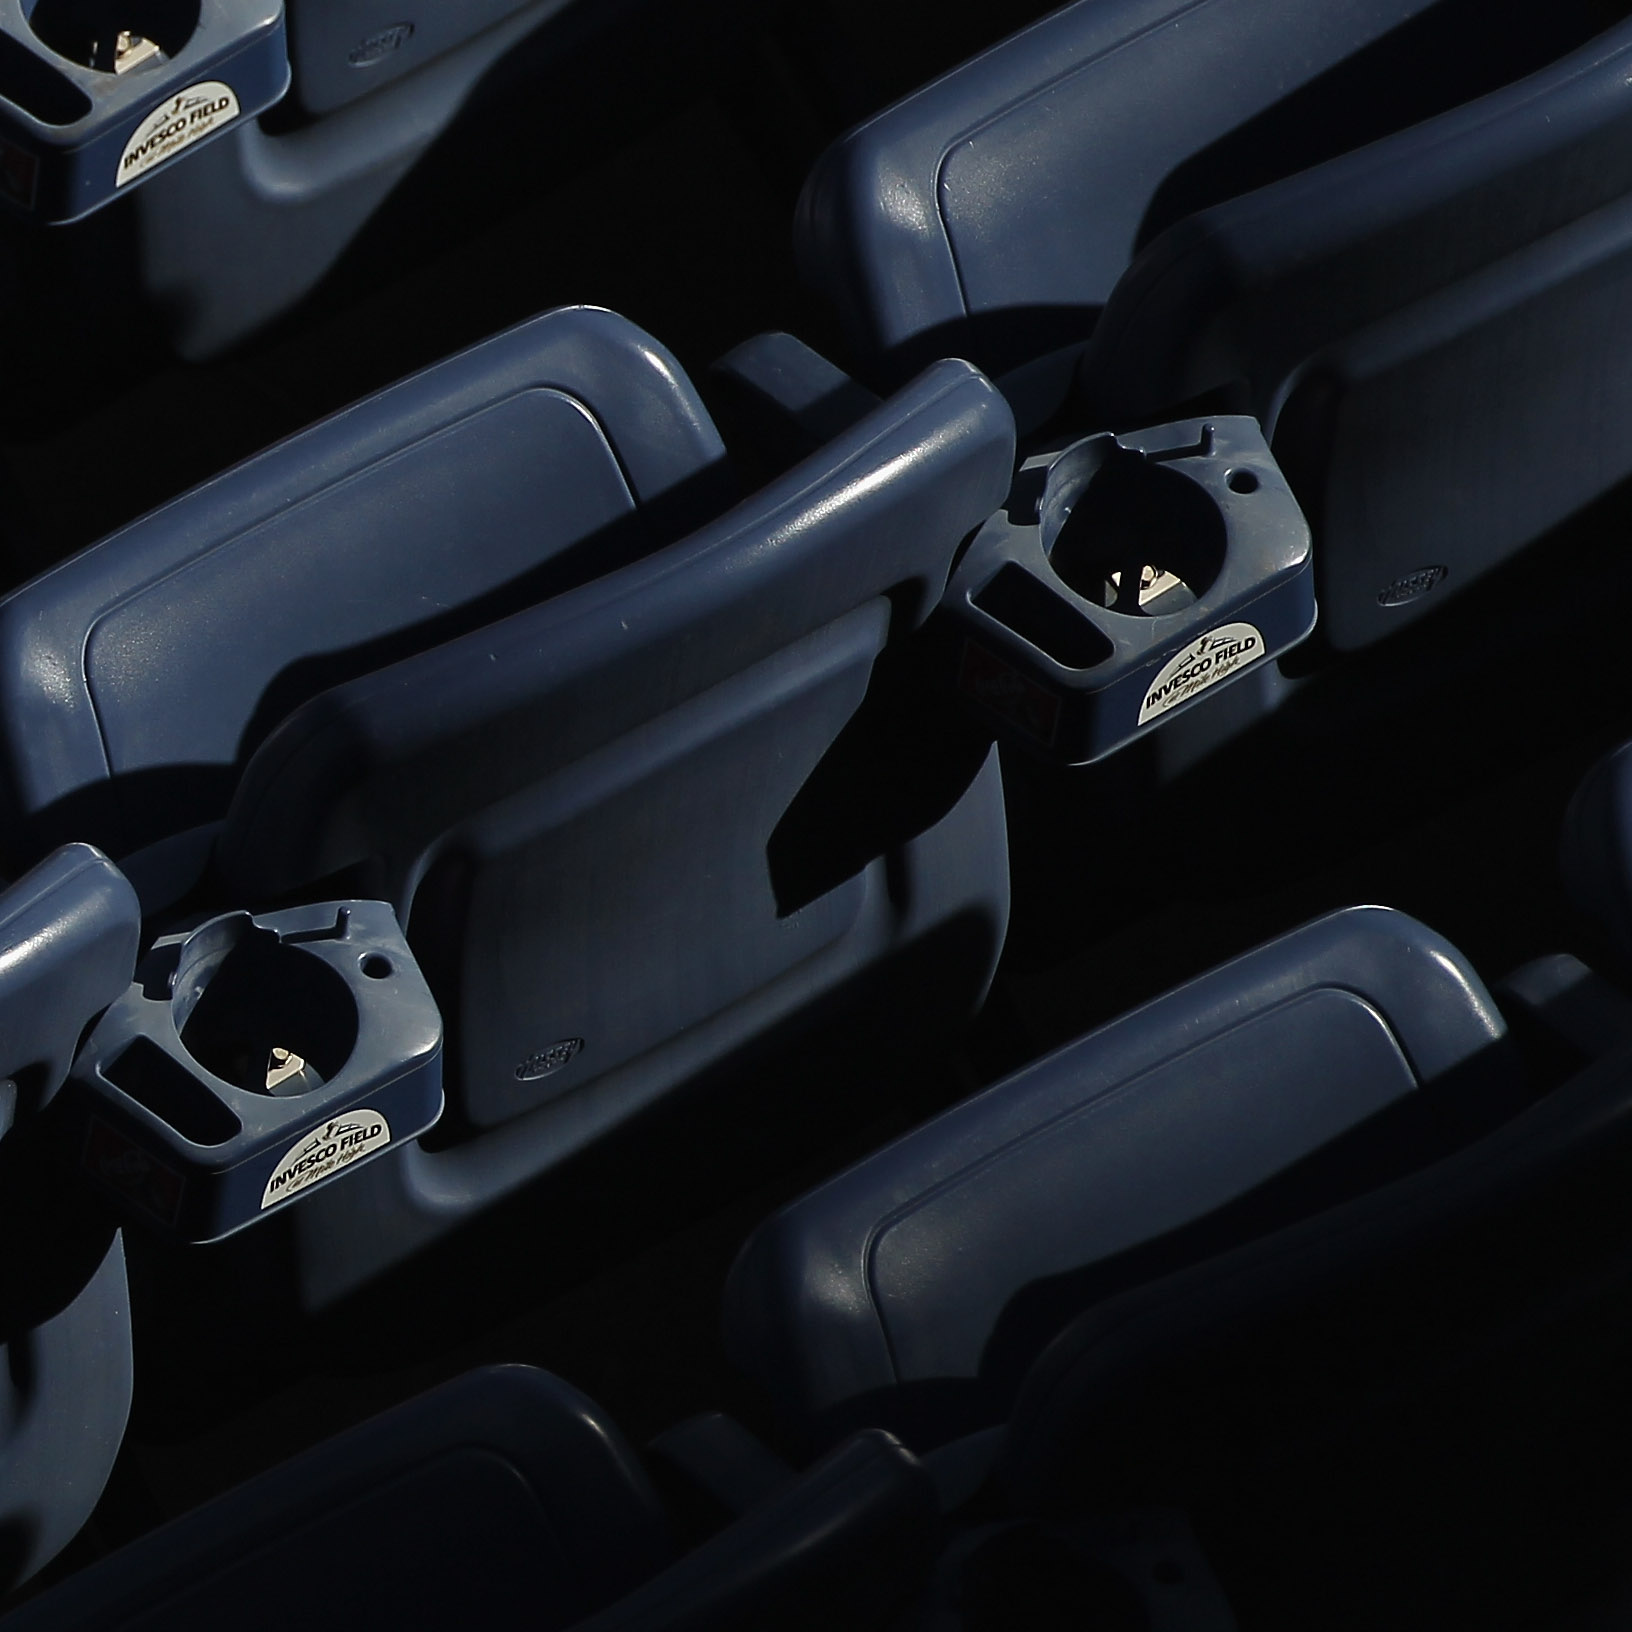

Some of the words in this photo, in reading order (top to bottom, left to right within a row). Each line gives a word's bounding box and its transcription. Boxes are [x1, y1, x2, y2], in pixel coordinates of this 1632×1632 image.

[123, 117, 187, 170] INVESCO
[189, 96, 230, 124] FIELD
[1145, 657, 1212, 710] INVESCO
[1214, 636, 1257, 665] FIELD
[269, 1143, 338, 1194] INVESCO
[339, 1123, 382, 1152] FIELD
